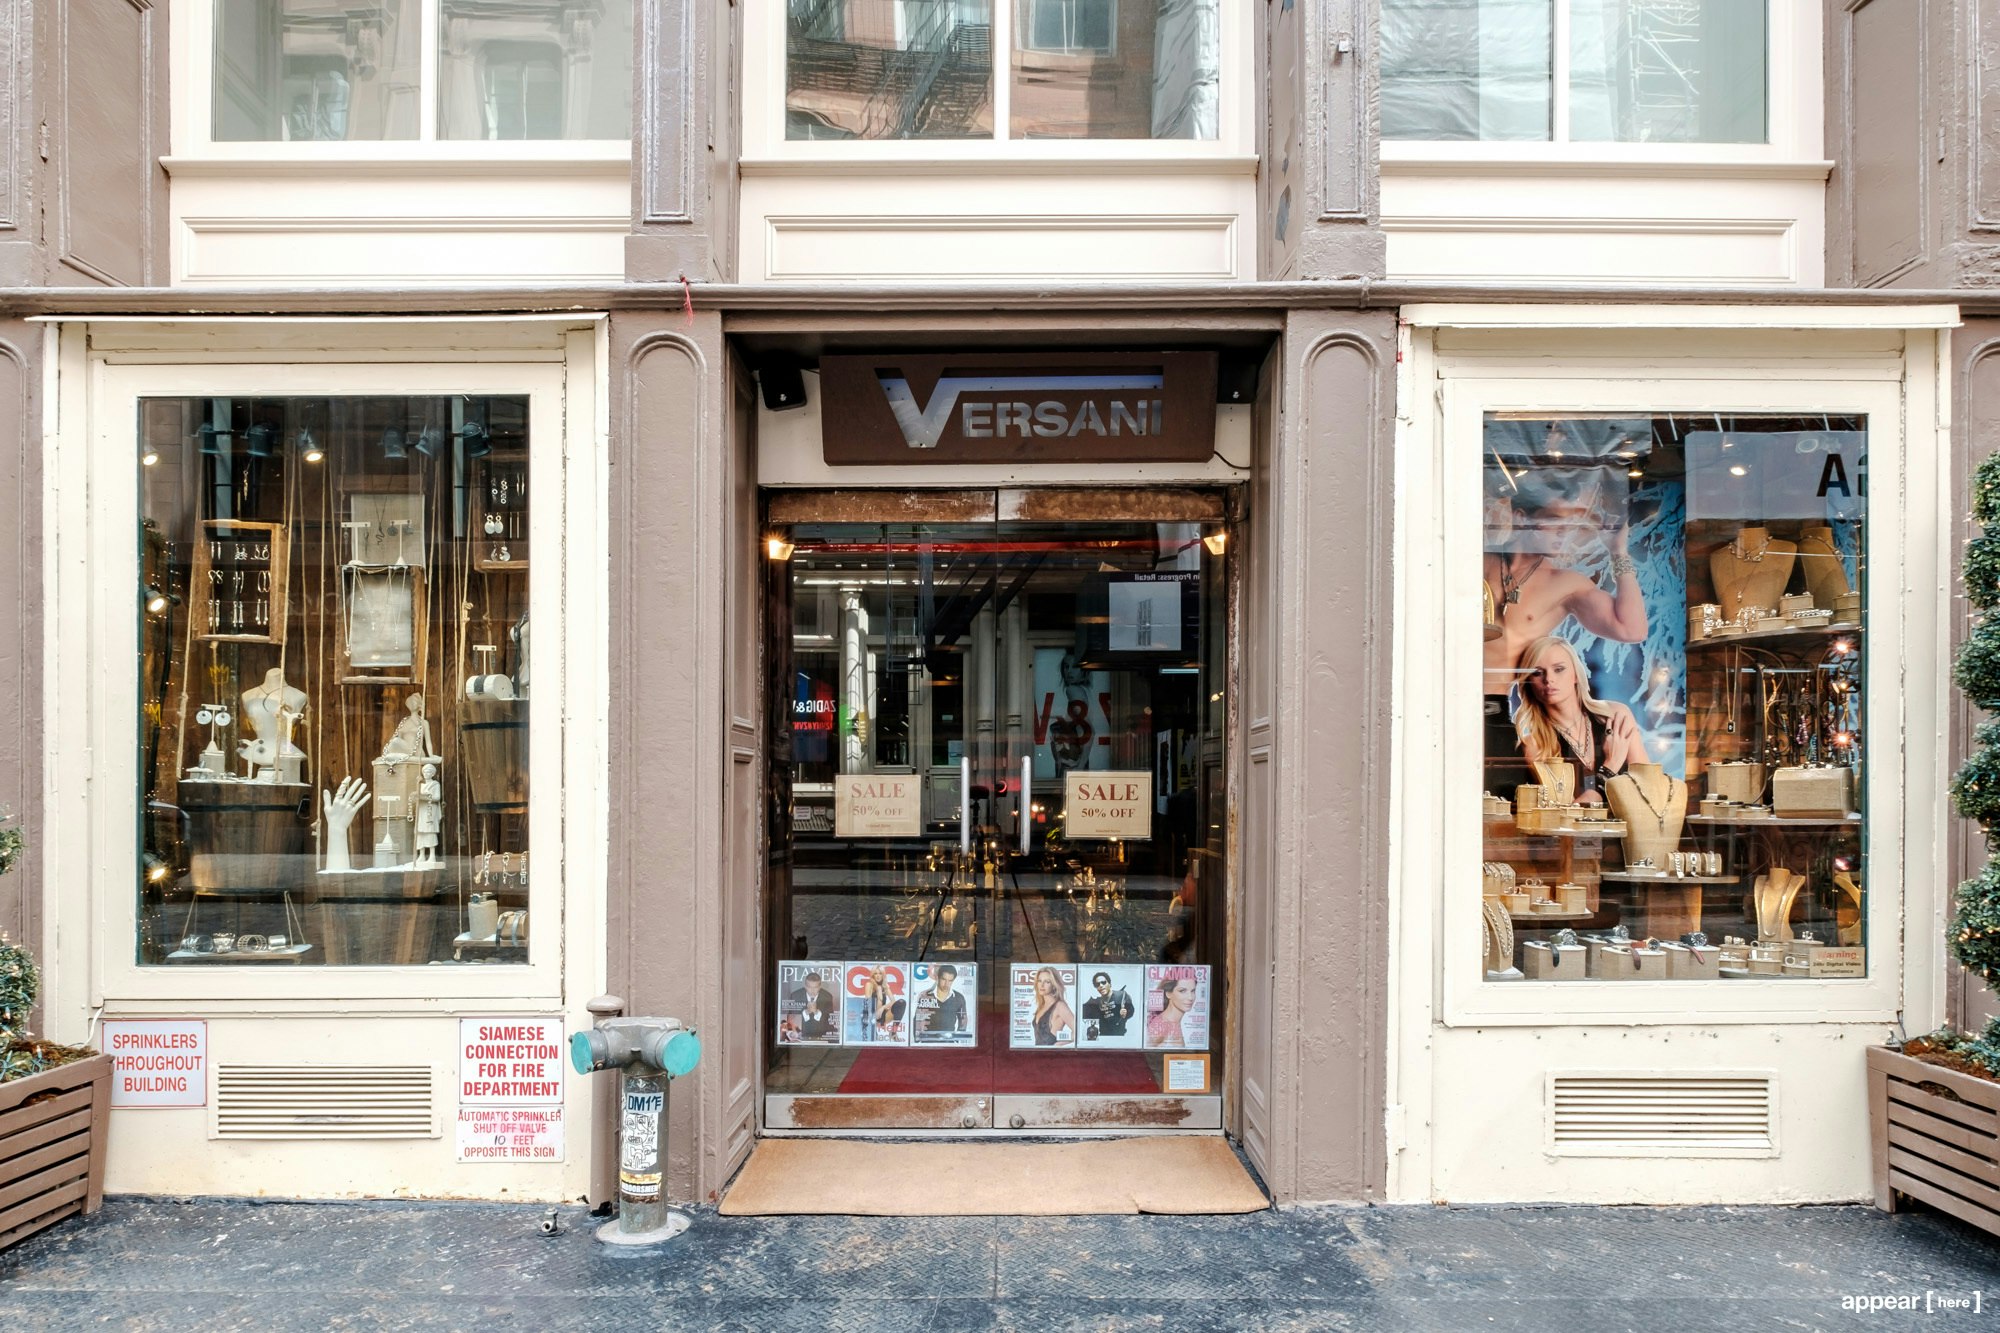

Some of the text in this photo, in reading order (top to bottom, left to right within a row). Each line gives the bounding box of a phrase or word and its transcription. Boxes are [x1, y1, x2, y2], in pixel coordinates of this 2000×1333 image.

[874, 367, 1163, 448] VERSANI
[851, 783, 905, 798] SALE
[1078, 783, 1139, 801] SALE
[852, 805, 904, 816] 50% OFF
[1081, 808, 1136, 818] 50% OFF
[846, 966, 905, 996] GQ
[479, 1026, 545, 1041] SIAMESE
[113, 1034, 198, 1049] SPRINKLERS
[465, 1045, 559, 1059] CONNECTION
[115, 1056, 202, 1071] HROUGHOUT
[478, 1063, 545, 1077] FOR FIRE
[124, 1077, 187, 1092] BUILDING
[463, 1082, 560, 1096] DEPARTMENT
[458, 1111, 562, 1121] AUTOMATIC SPRINKLER
[473, 1123, 547, 1133] SHUT OFF VALVE
[494, 1135, 506, 1146] 10
[513, 1136, 535, 1145] FEET
[464, 1147, 555, 1157] OPPOSITE THIS SIGN
